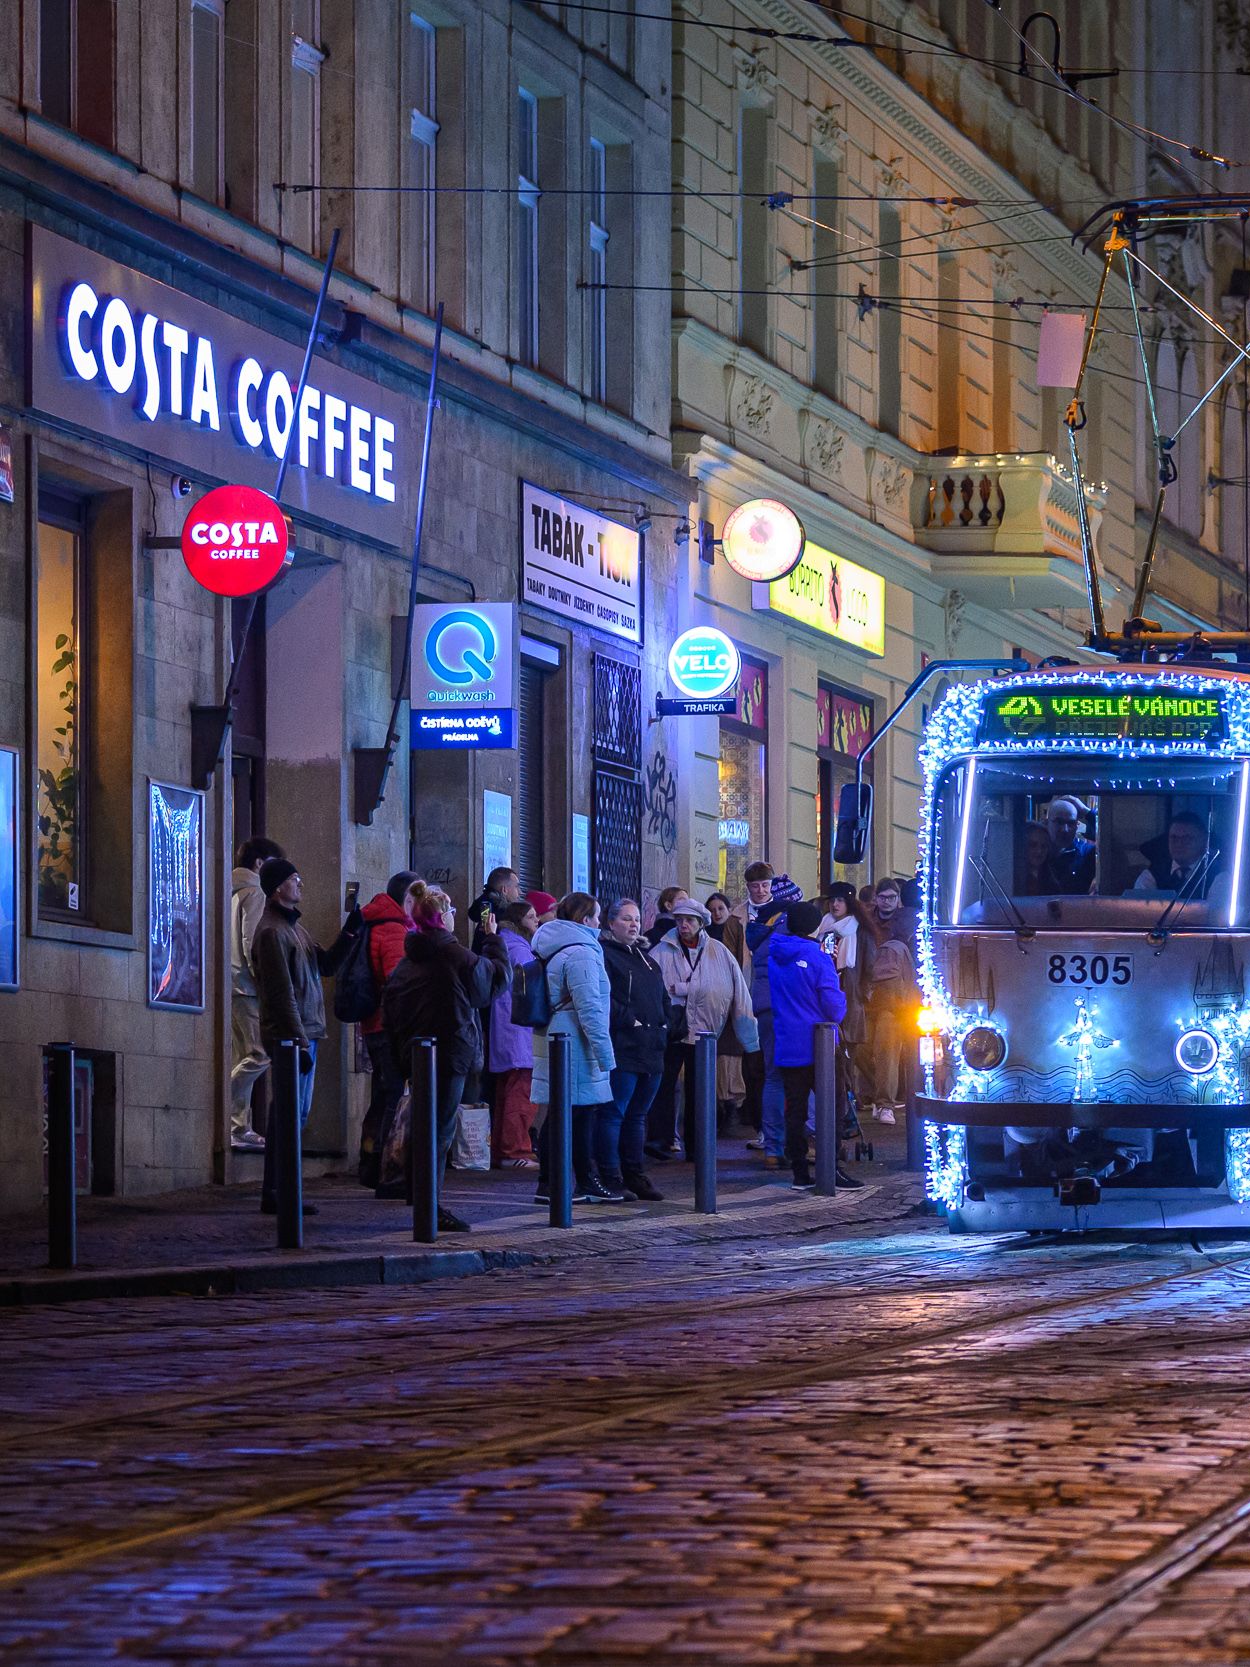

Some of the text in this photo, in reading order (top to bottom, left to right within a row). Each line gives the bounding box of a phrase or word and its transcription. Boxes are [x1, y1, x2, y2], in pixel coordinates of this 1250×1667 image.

[67, 283, 396, 502] COSTA COFFEE
[190, 522, 279, 547] COSTA
[532, 503, 584, 568] TABÁK
[210, 549, 260, 560] COFFEE
[621, 614, 636, 632] SAZKA
[673, 653, 731, 671] VELO
[427, 688, 496, 702] Quickwash
[684, 703, 725, 712] TRAFIKA
[1052, 696, 1219, 716] VESELÉ VÁNOCE
[420, 716, 464, 728] ČISTÍRNA
[1048, 954, 1131, 985] 8305
